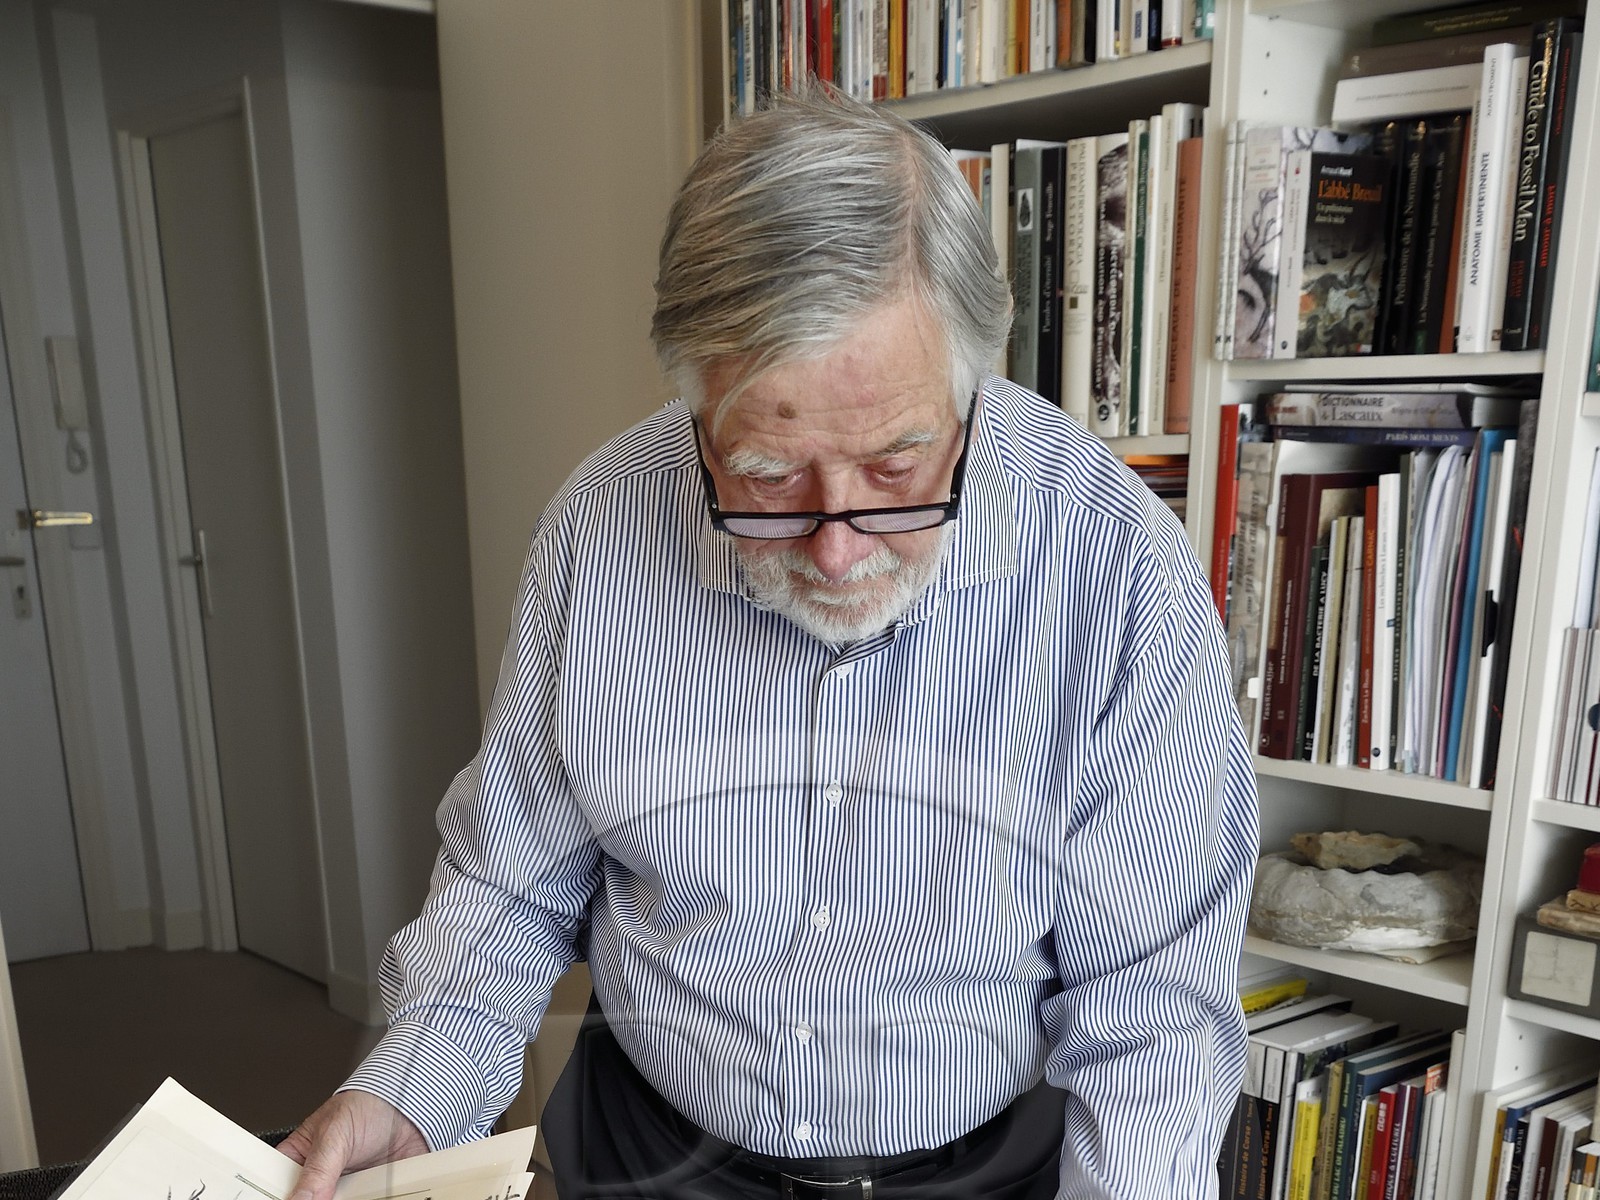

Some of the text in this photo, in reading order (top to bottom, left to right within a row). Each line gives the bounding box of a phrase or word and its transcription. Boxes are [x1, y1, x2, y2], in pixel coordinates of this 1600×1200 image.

[1513, 60, 1545, 242] Guide to Fossil Man
[1393, 152, 1421, 305] Préhistoire de la Normandie
[1468, 151, 1491, 286] ANATOMIE IMPERTINENTE
[1172, 281, 1181, 298] DE
[1168, 305, 1180, 383] BERCEAUX
[1320, 394, 1384, 407] DICTIONNAIRE
[1331, 408, 1384, 422] Lascaux
[1366, 528, 1375, 567] CARNAC
[1319, 570, 1328, 594] LUCY
[1314, 606, 1325, 648] BACTERIE
[1313, 651, 1321, 663] LA
[1312, 664, 1320, 676] DE
[1242, 1126, 1251, 1150] Corse
[1261, 1130, 1271, 1155] Corse
[1335, 1116, 1346, 1153] PALADRU
[1390, 1121, 1401, 1162] CULTUREL
[1241, 1152, 1249, 1162] de
[1260, 1156, 1268, 1166] de
[1334, 1154, 1342, 1166] DE
[1238, 1163, 1248, 1196] Histoire
[1257, 1167, 1267, 1200] Histoire
[1332, 1166, 1341, 1181] LAC
[1332, 1182, 1340, 1195] DU
